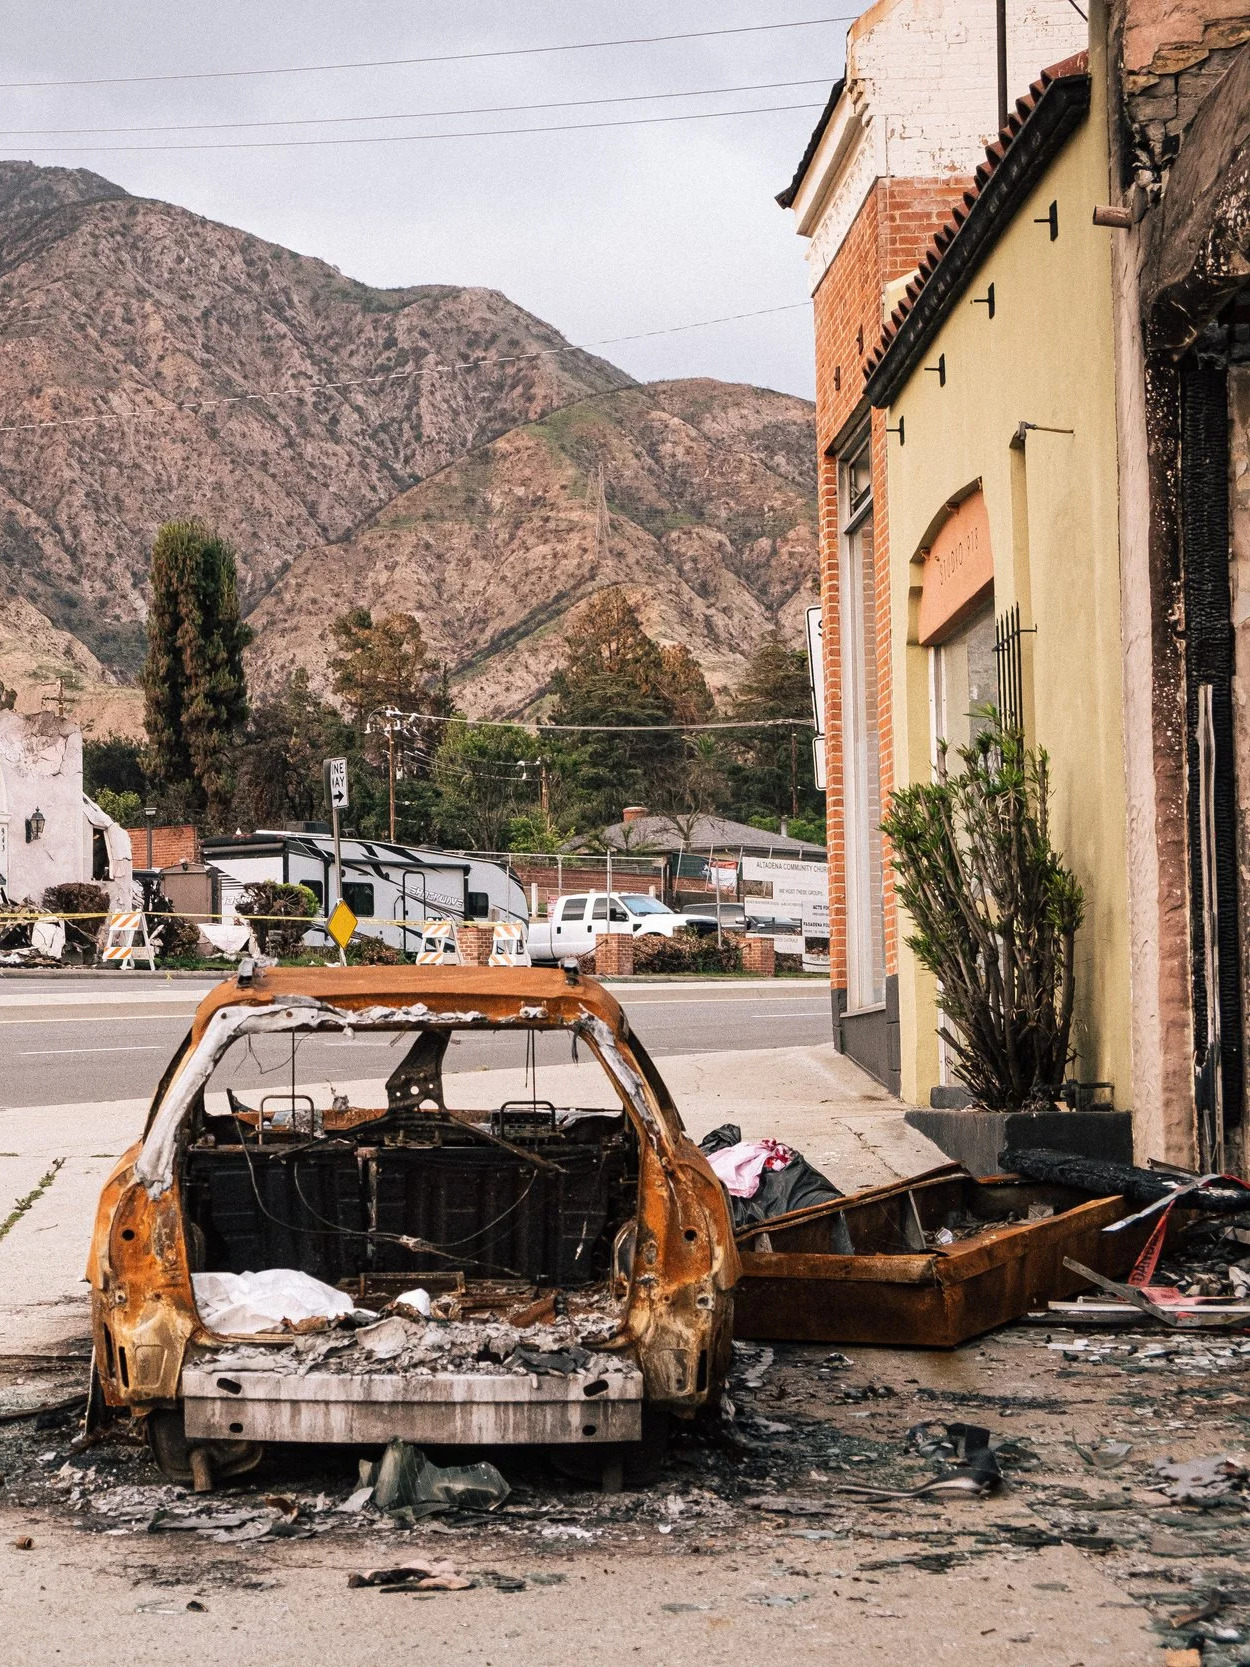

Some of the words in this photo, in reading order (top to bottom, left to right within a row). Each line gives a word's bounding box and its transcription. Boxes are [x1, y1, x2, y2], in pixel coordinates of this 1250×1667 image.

[940, 542, 963, 586] STUDIO
[332, 763, 344, 775] NE
[332, 776, 345, 788] AY
[756, 861, 782, 869] ALTADENA
[783, 863, 813, 871] COMMUNITY
